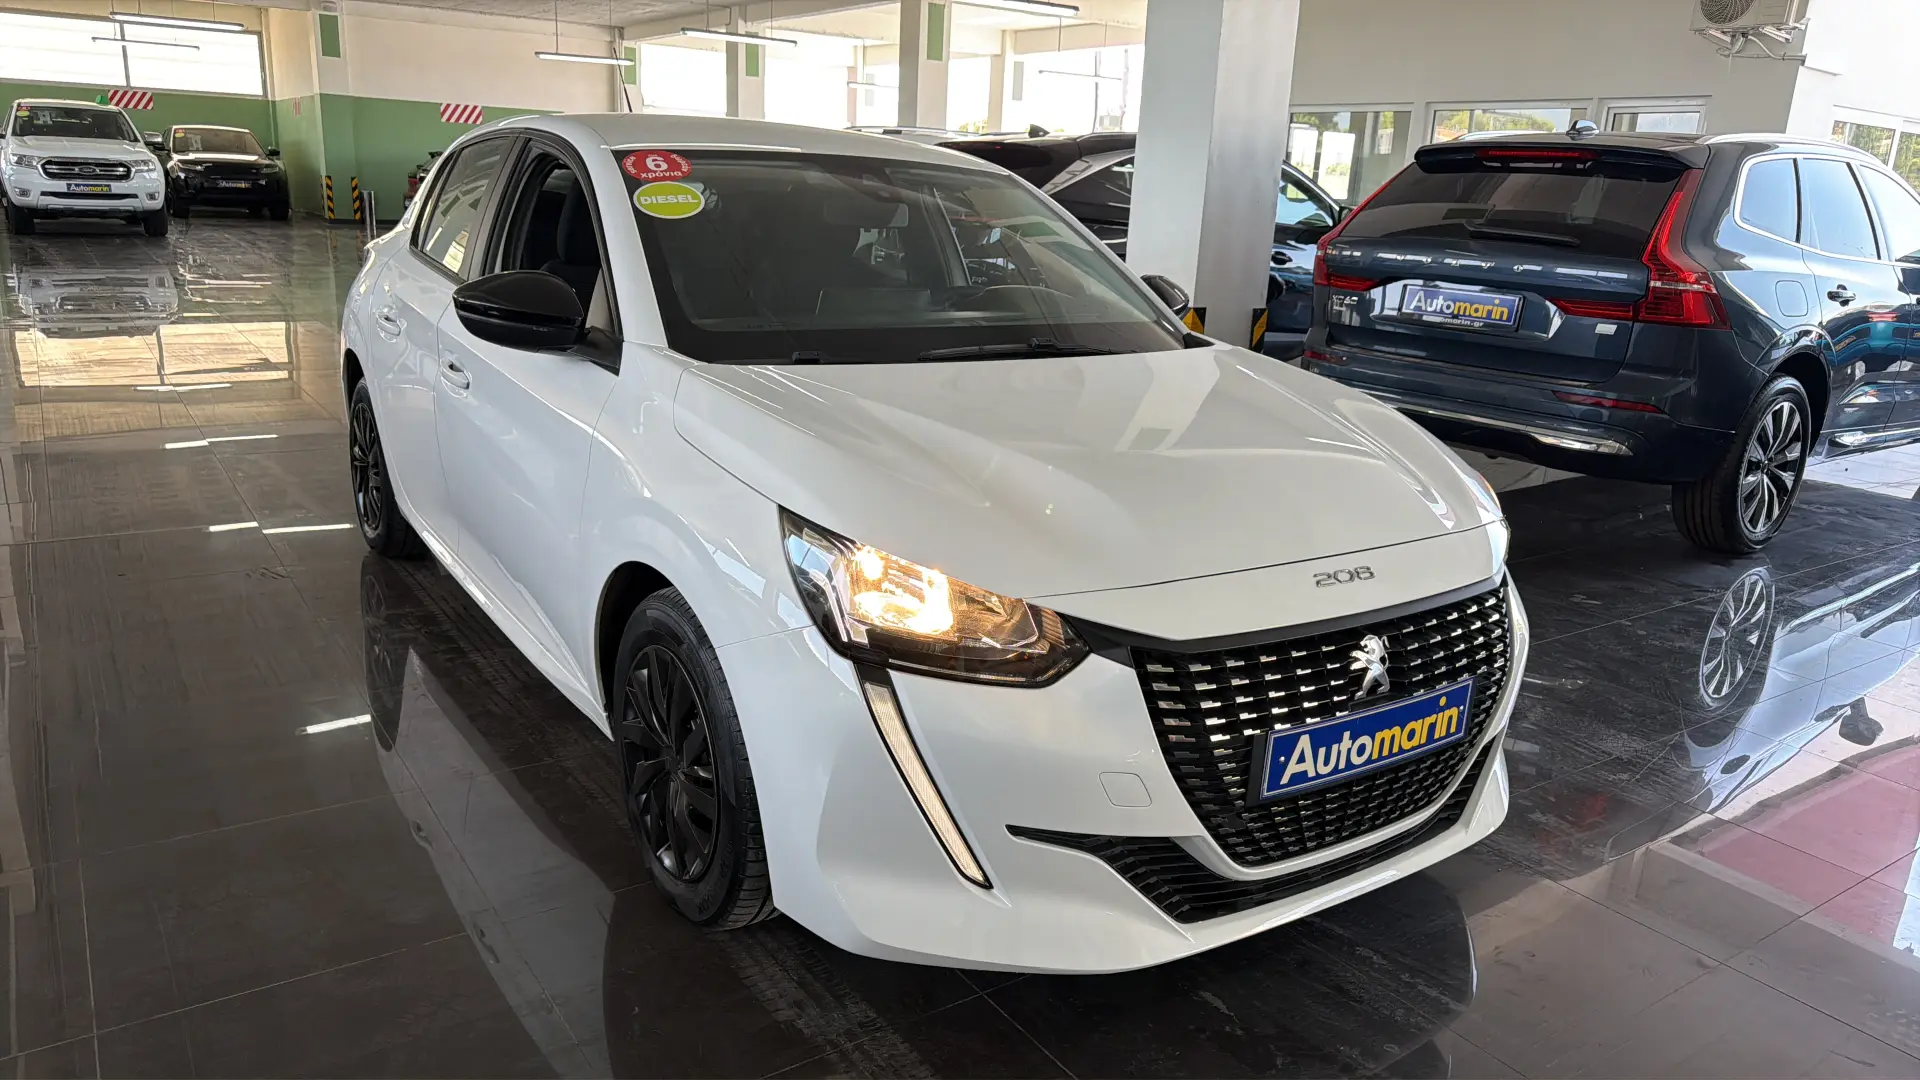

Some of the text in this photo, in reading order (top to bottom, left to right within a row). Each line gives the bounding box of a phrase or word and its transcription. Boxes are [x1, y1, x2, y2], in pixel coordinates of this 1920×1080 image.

[646, 156, 668, 171] 6
[640, 170, 682, 178] χρόνια
[70, 184, 110, 192] Automarin
[640, 195, 698, 204] DIESEL
[1410, 290, 1509, 321] Automarin
[1313, 566, 1376, 588] 208
[1280, 696, 1458, 785] Automarin
